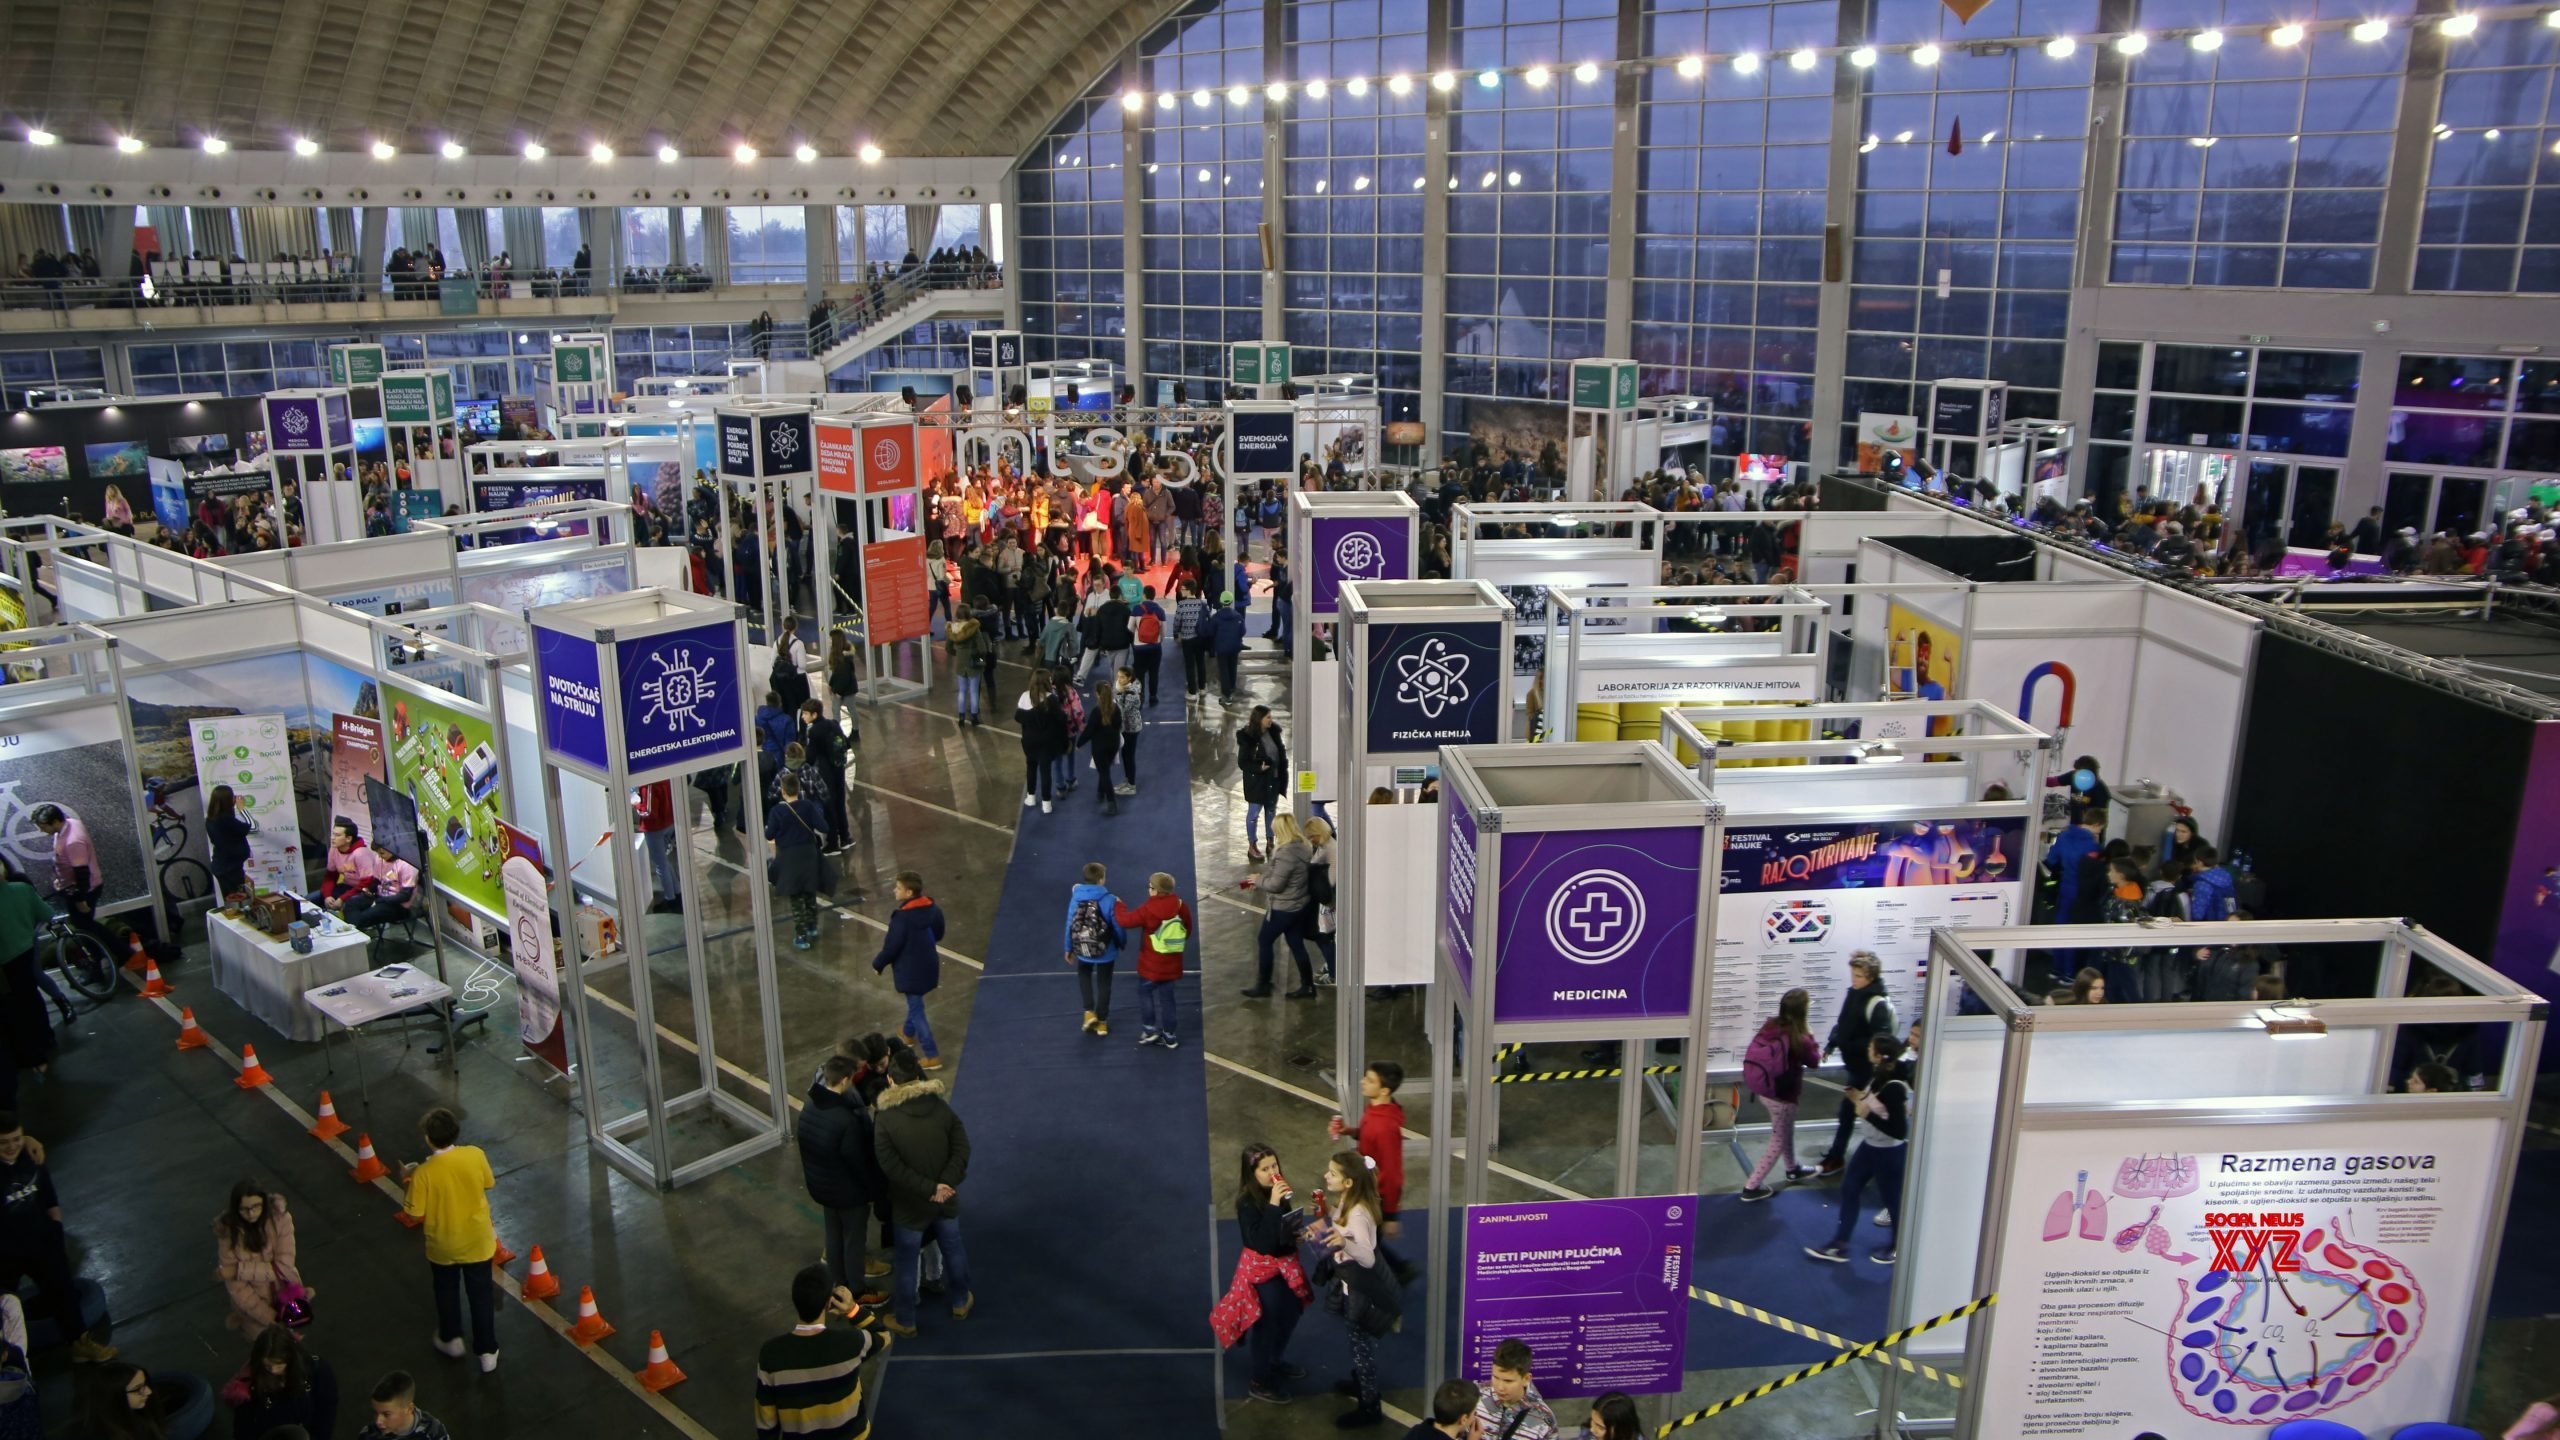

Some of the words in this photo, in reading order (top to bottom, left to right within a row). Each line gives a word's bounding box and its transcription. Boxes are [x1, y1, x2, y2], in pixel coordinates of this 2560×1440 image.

[1239, 432, 1288, 443] SVEMOGUĆA
[956, 414, 1126, 478] mts
[1239, 442, 1277, 450] ENERGIJA
[343, 599, 355, 607] DO
[548, 675, 601, 705] DVOTOČKAŠ
[1597, 683, 1669, 691] LABORATORIJA
[1765, 681, 1800, 689] MITOVA
[551, 690, 564, 707] NA
[564, 694, 596, 717] STRUJU
[341, 721, 375, 736] H-Bridges
[1392, 729, 1432, 739] FIZIČKA
[1434, 730, 1471, 738] HEMIJA
[629, 741, 682, 760] ENERGETSKA
[682, 728, 735, 748] ELEKTRONIKA
[1731, 833, 1772, 842] FESTIVAL
[1731, 842, 1762, 850] NAUKE
[1553, 988, 1628, 1000] MEDICINA
[2220, 1154, 2337, 1173] Razmena
[2344, 1154, 2436, 1176] gasova
[2217, 1179, 2250, 1189] plućima
[2220, 1188, 2263, 1197] spoljašnje
[2307, 1187, 2351, 1195] udahnutog
[2321, 1196, 2352, 1204] otpušta
[2361, 1195, 2403, 1204] spoljašnju
[1479, 1213, 1549, 1223] ZANIMLJIVOSTI
[1477, 1251, 1518, 1263] ŽIVETI
[1520, 1248, 1563, 1260] PUNIM
[1565, 1245, 1622, 1259] PLUĆIMA
[1663, 1255, 1672, 1284] NAUKE
[1670, 1256, 1681, 1291] FESTIVAL
[2044, 1270, 2101, 1279] Ugljen-dioksid
[2112, 1269, 2142, 1277] otpušta
[2042, 1286, 2075, 1294] kiseonik
[2077, 1302, 2116, 1310] procesom
[2117, 1301, 2145, 1309] difuzije
[1579, 1314, 1585, 1322] 6
[2039, 1311, 2068, 1319] prolaze
[2087, 1309, 2134, 1317] respiratornu
[2037, 1327, 2054, 1335] koju
[2043, 1342, 2078, 1350] kapilarna
[1473, 1361, 1480, 1369] 4
[2039, 1366, 2079, 1374] alveolarna
[1572, 1377, 1581, 1385] 10
[2083, 1411, 2103, 1419] broju
[2022, 1428, 2039, 1436] pola
